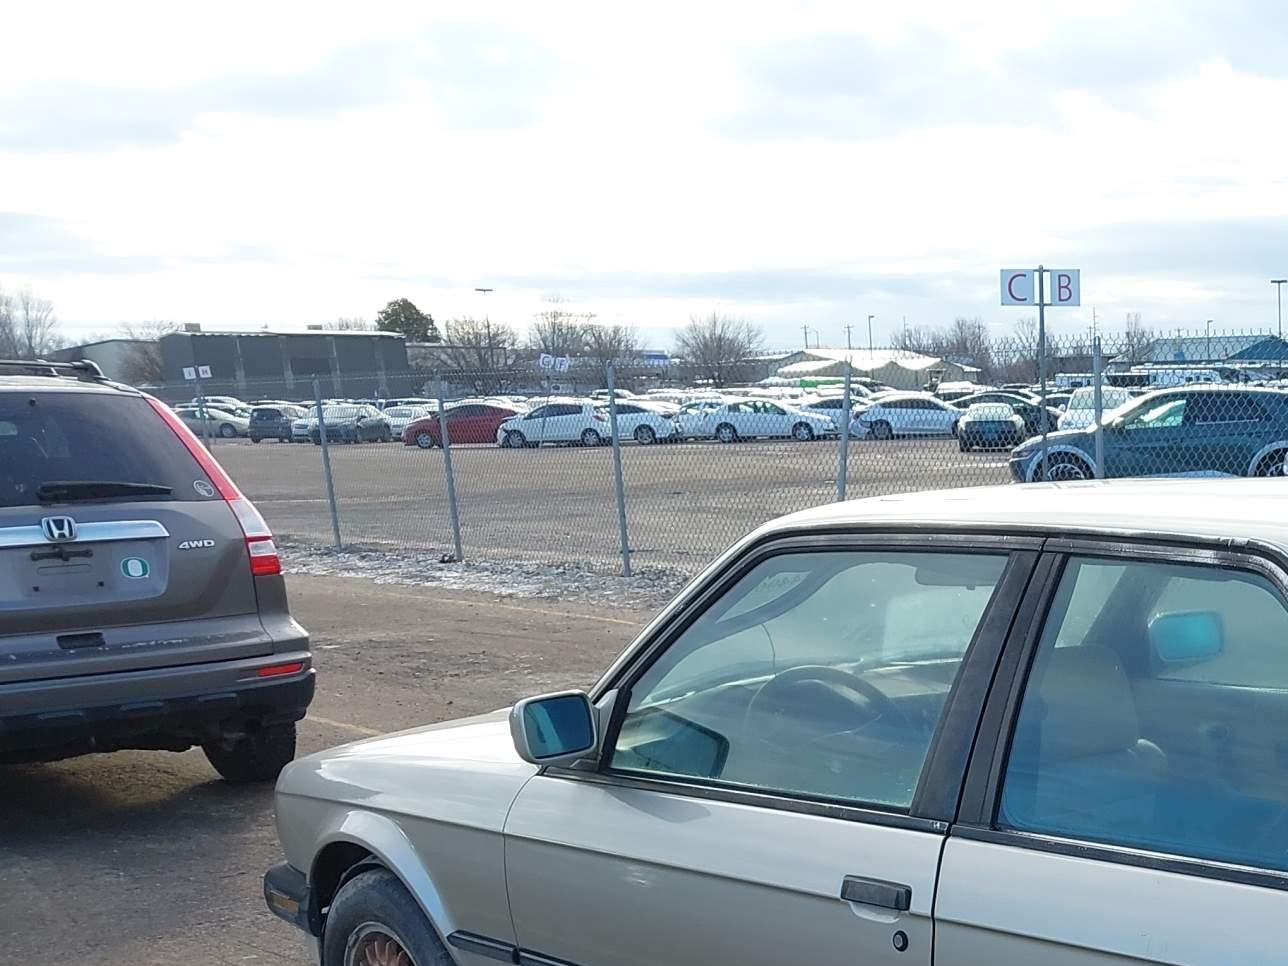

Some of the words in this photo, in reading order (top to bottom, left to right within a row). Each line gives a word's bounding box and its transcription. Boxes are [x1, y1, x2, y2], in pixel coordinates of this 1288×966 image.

[1008, 273, 1028, 302] C
[1057, 273, 1073, 302] B
[179, 539, 215, 549] 4WD
